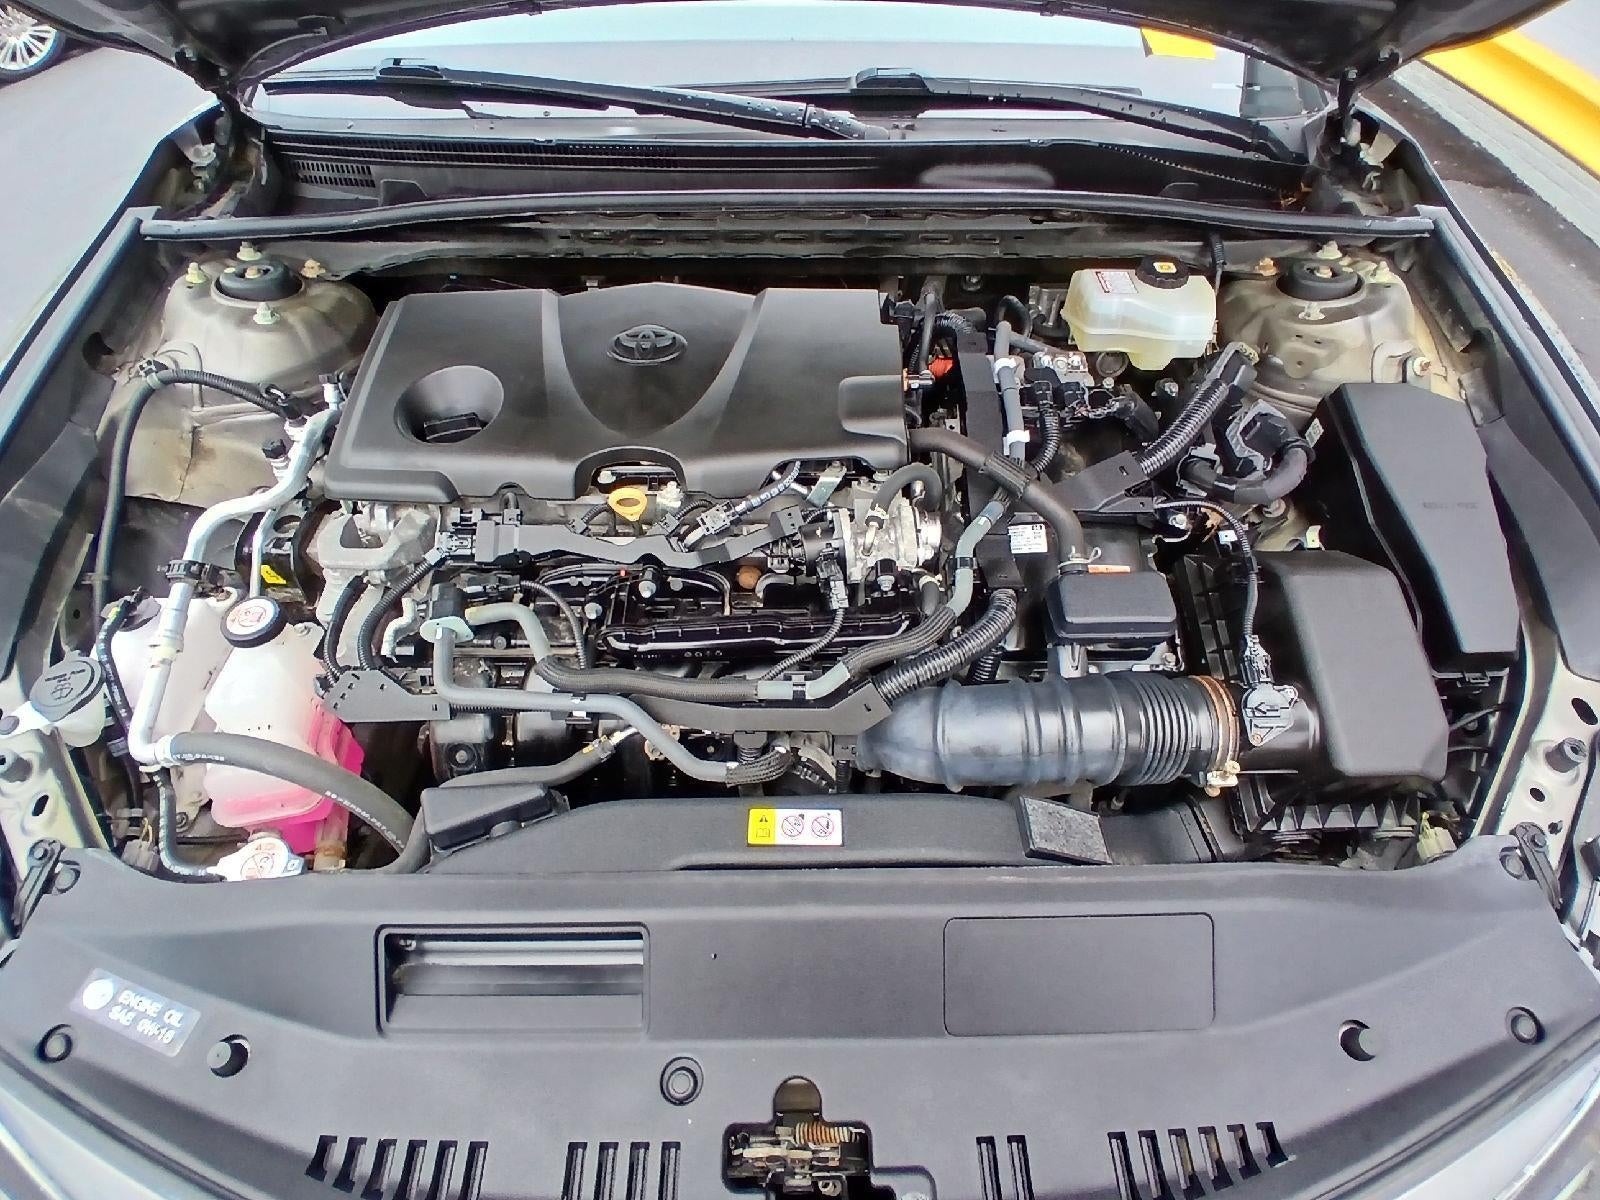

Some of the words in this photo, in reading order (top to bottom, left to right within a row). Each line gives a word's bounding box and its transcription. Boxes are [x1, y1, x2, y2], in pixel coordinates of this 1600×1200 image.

[109, 1005, 136, 1025] SAE
[119, 990, 162, 1017] ENGINE
[164, 1009, 183, 1027] OIL
